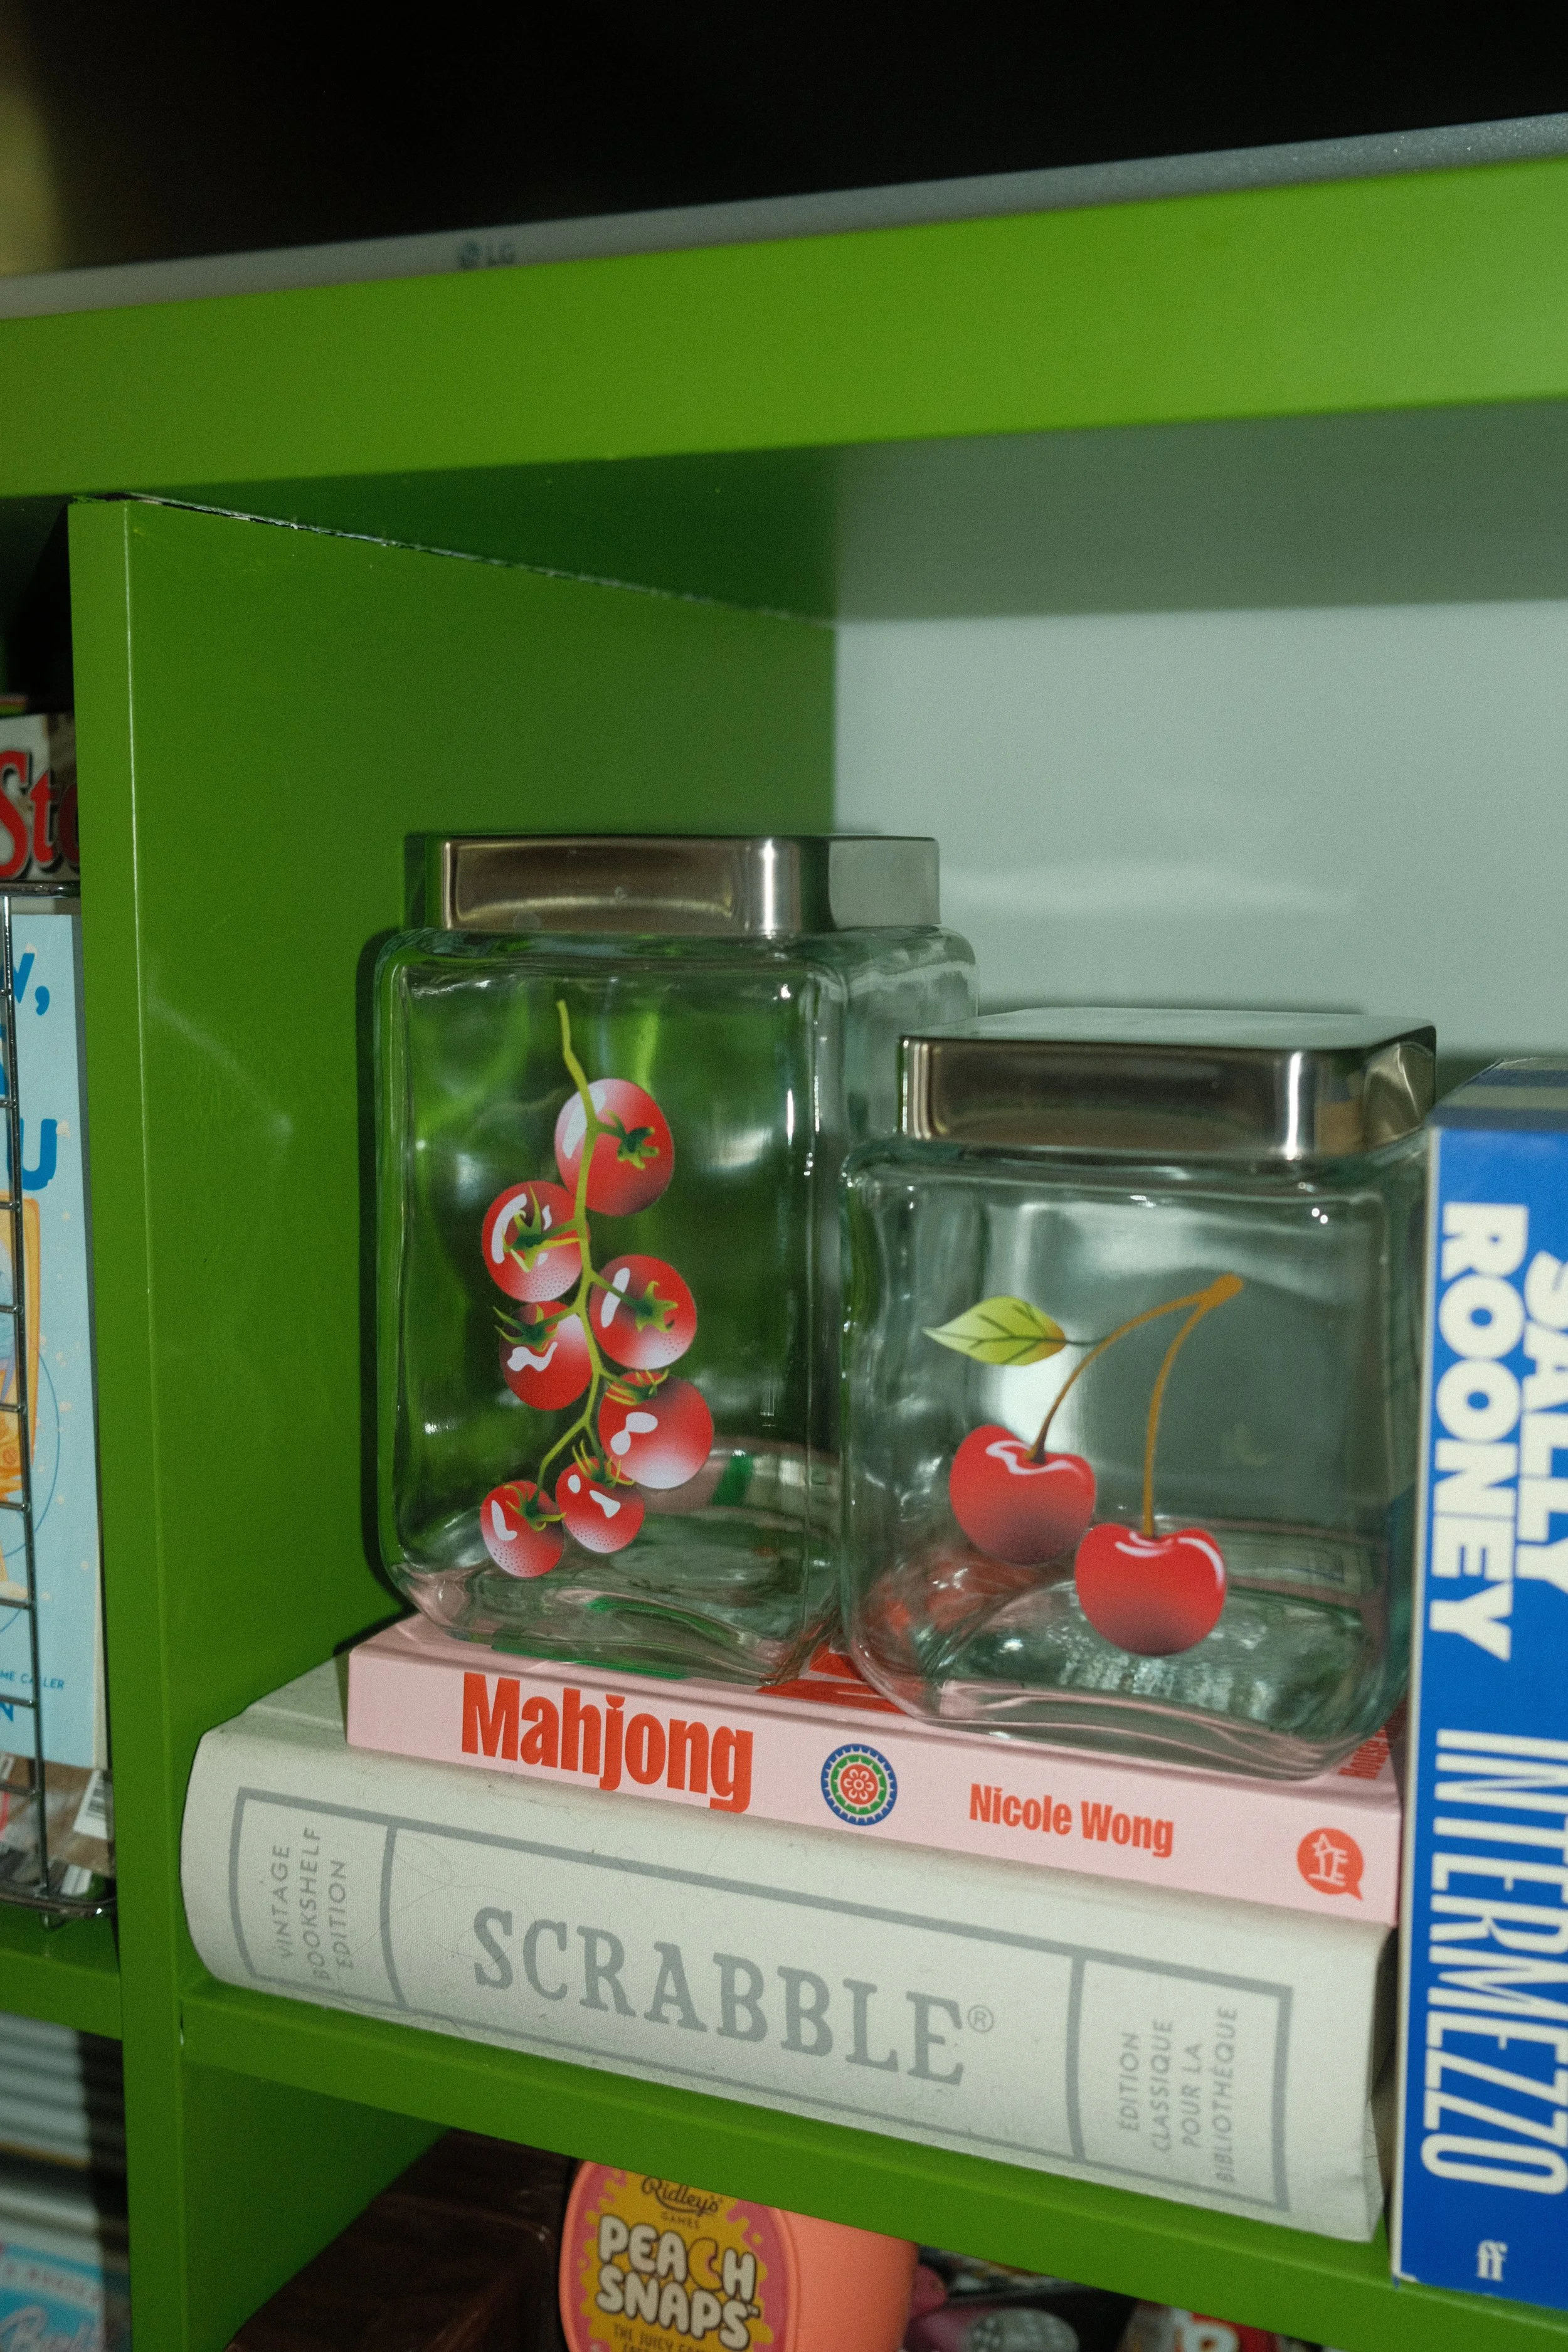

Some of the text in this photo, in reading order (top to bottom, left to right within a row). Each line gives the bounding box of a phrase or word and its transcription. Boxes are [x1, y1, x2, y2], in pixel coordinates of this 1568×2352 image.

[1430, 1202, 1528, 1661] ROONEY
[462, 1672, 753, 1813] Mahjong
[970, 1783, 1174, 1858] Nicole Wong
[270, 1845, 293, 1958] VINTAGE
[299, 1826, 330, 1980] BOOKSHELF
[328, 1859, 354, 1969] EDITION
[1421, 1729, 1568, 2195] INTERMEZZO
[1150, 2018, 1173, 2151] CLASSIQUE
[1182, 2042, 1202, 2148] POUR LA
[598, 2213, 756, 2303] PEACH
[661, 2212, 700, 2229] GAMES
